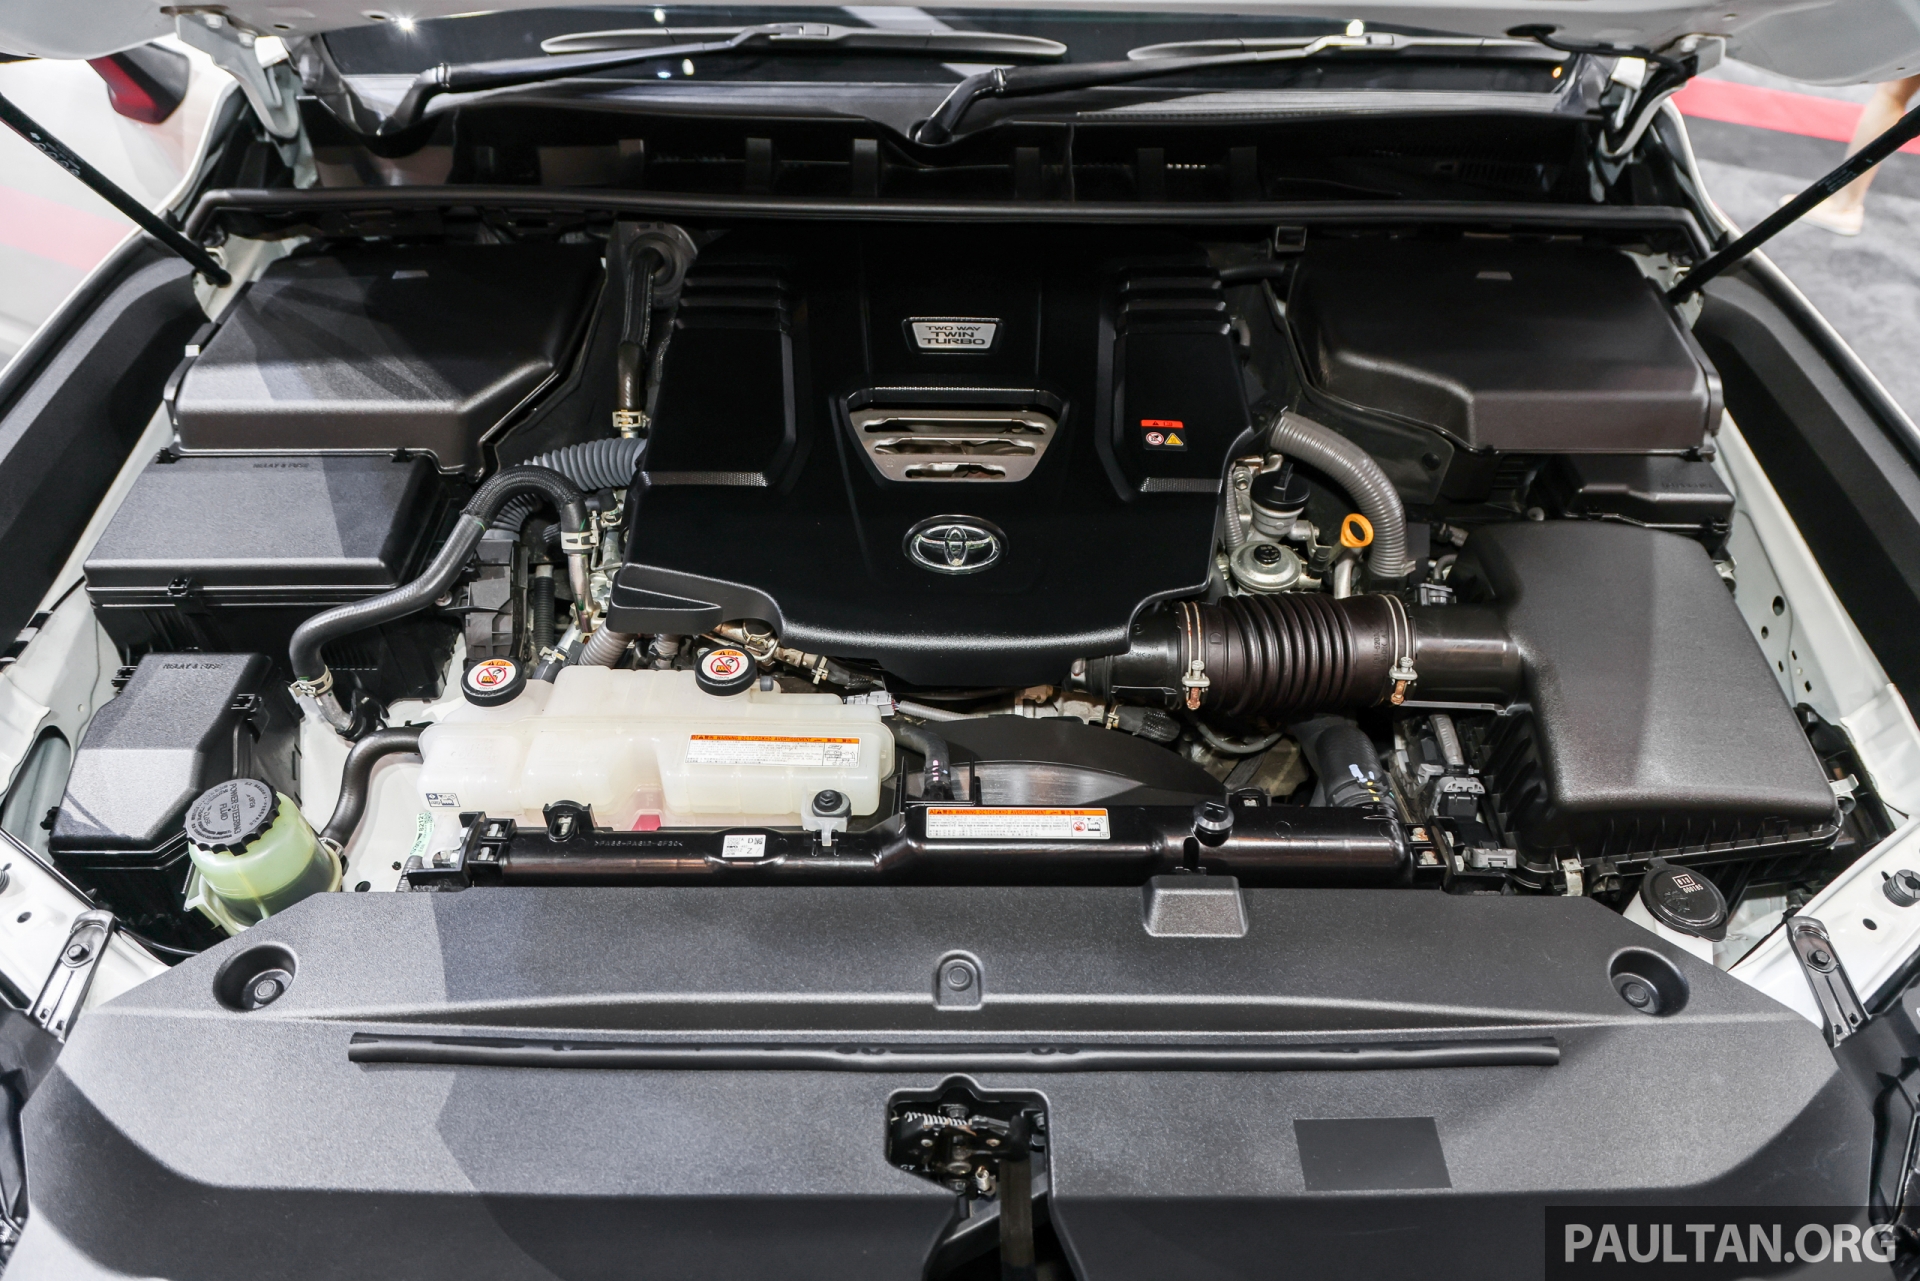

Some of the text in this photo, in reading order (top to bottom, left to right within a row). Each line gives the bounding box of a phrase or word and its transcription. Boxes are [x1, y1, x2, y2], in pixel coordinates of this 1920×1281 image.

[219, 802, 228, 821] FLUID
[230, 783, 242, 835] POWER STEERING
